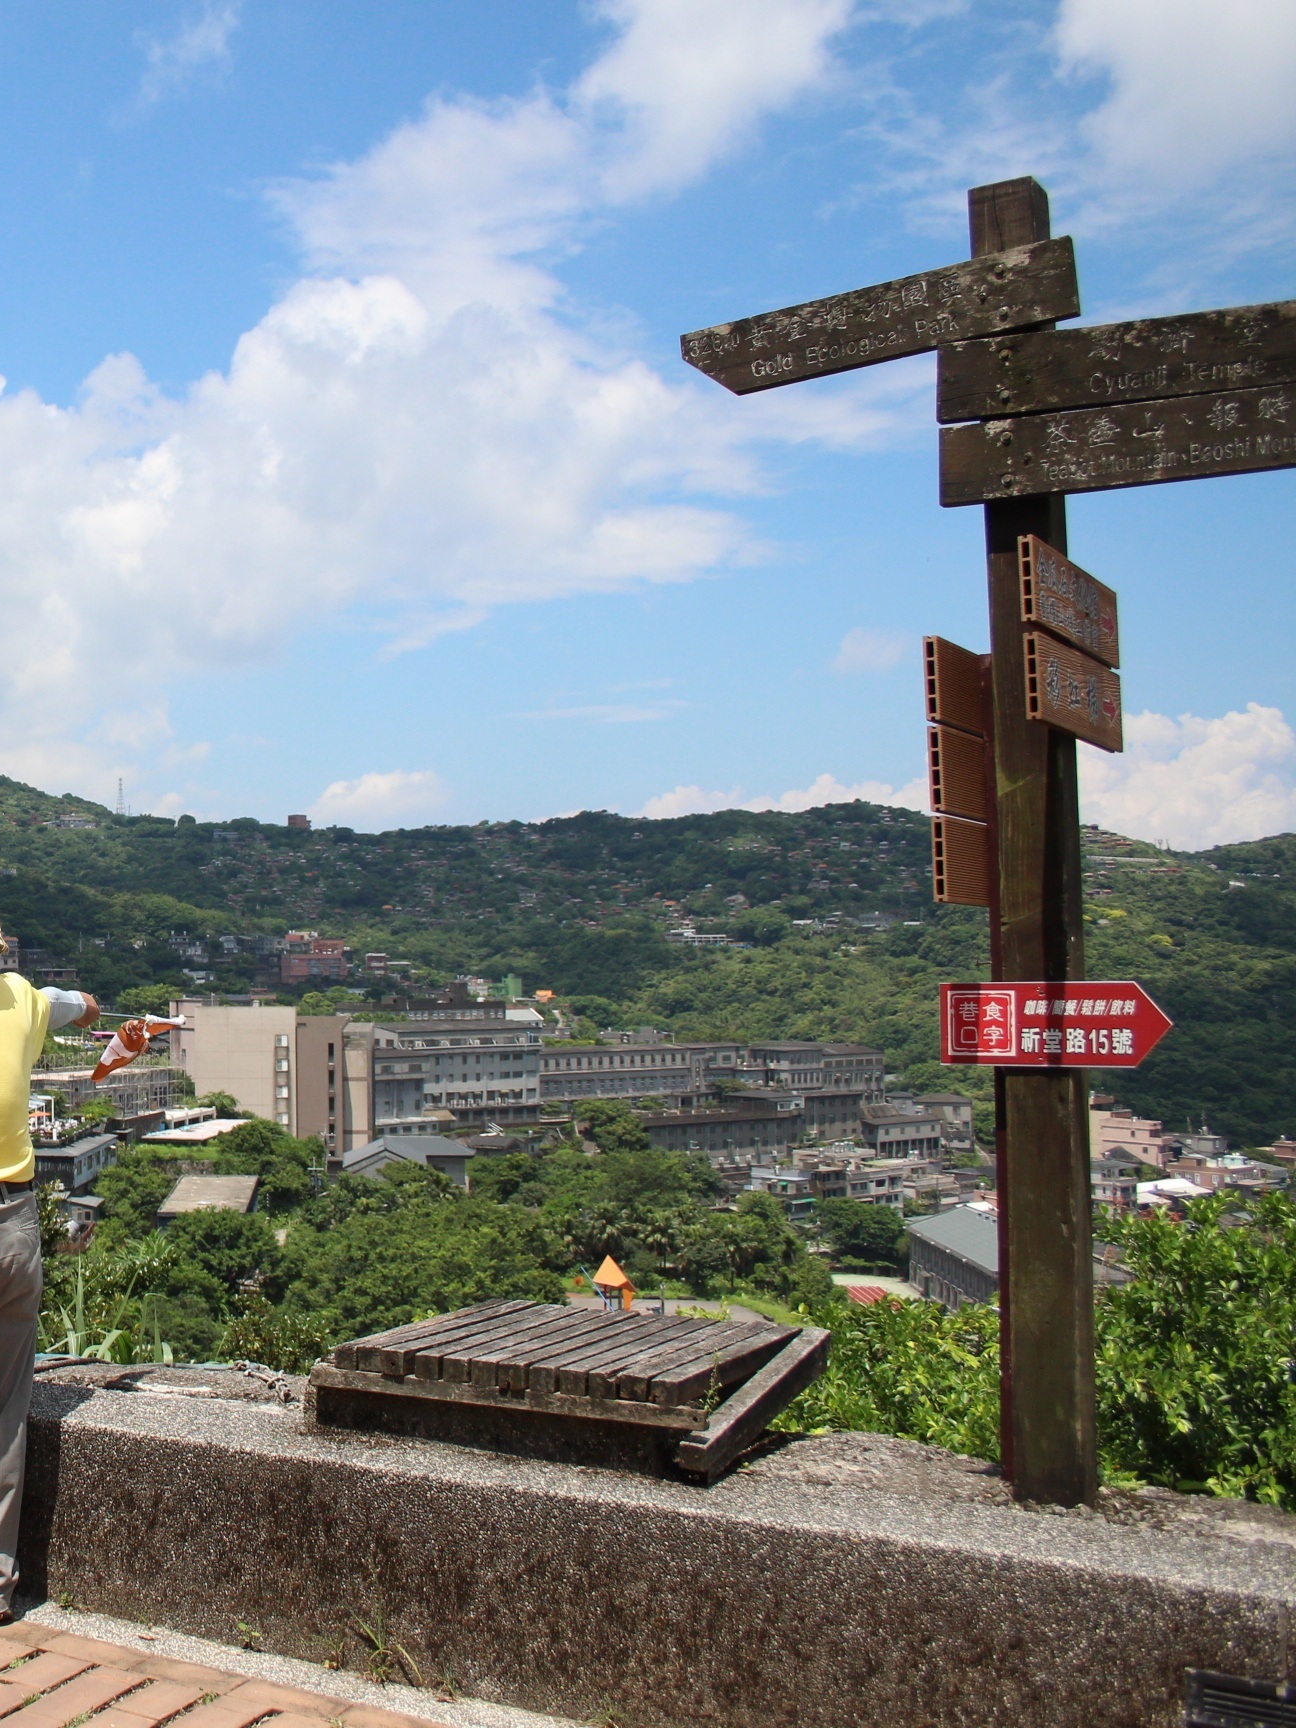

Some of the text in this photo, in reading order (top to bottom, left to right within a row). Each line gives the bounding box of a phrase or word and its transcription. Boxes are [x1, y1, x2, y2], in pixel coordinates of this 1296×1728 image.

[751, 313, 960, 378] Gold Ecological Park
[1183, 355, 1267, 382] Temple
[1021, 1027, 1133, 1054] 祈堂路15號
